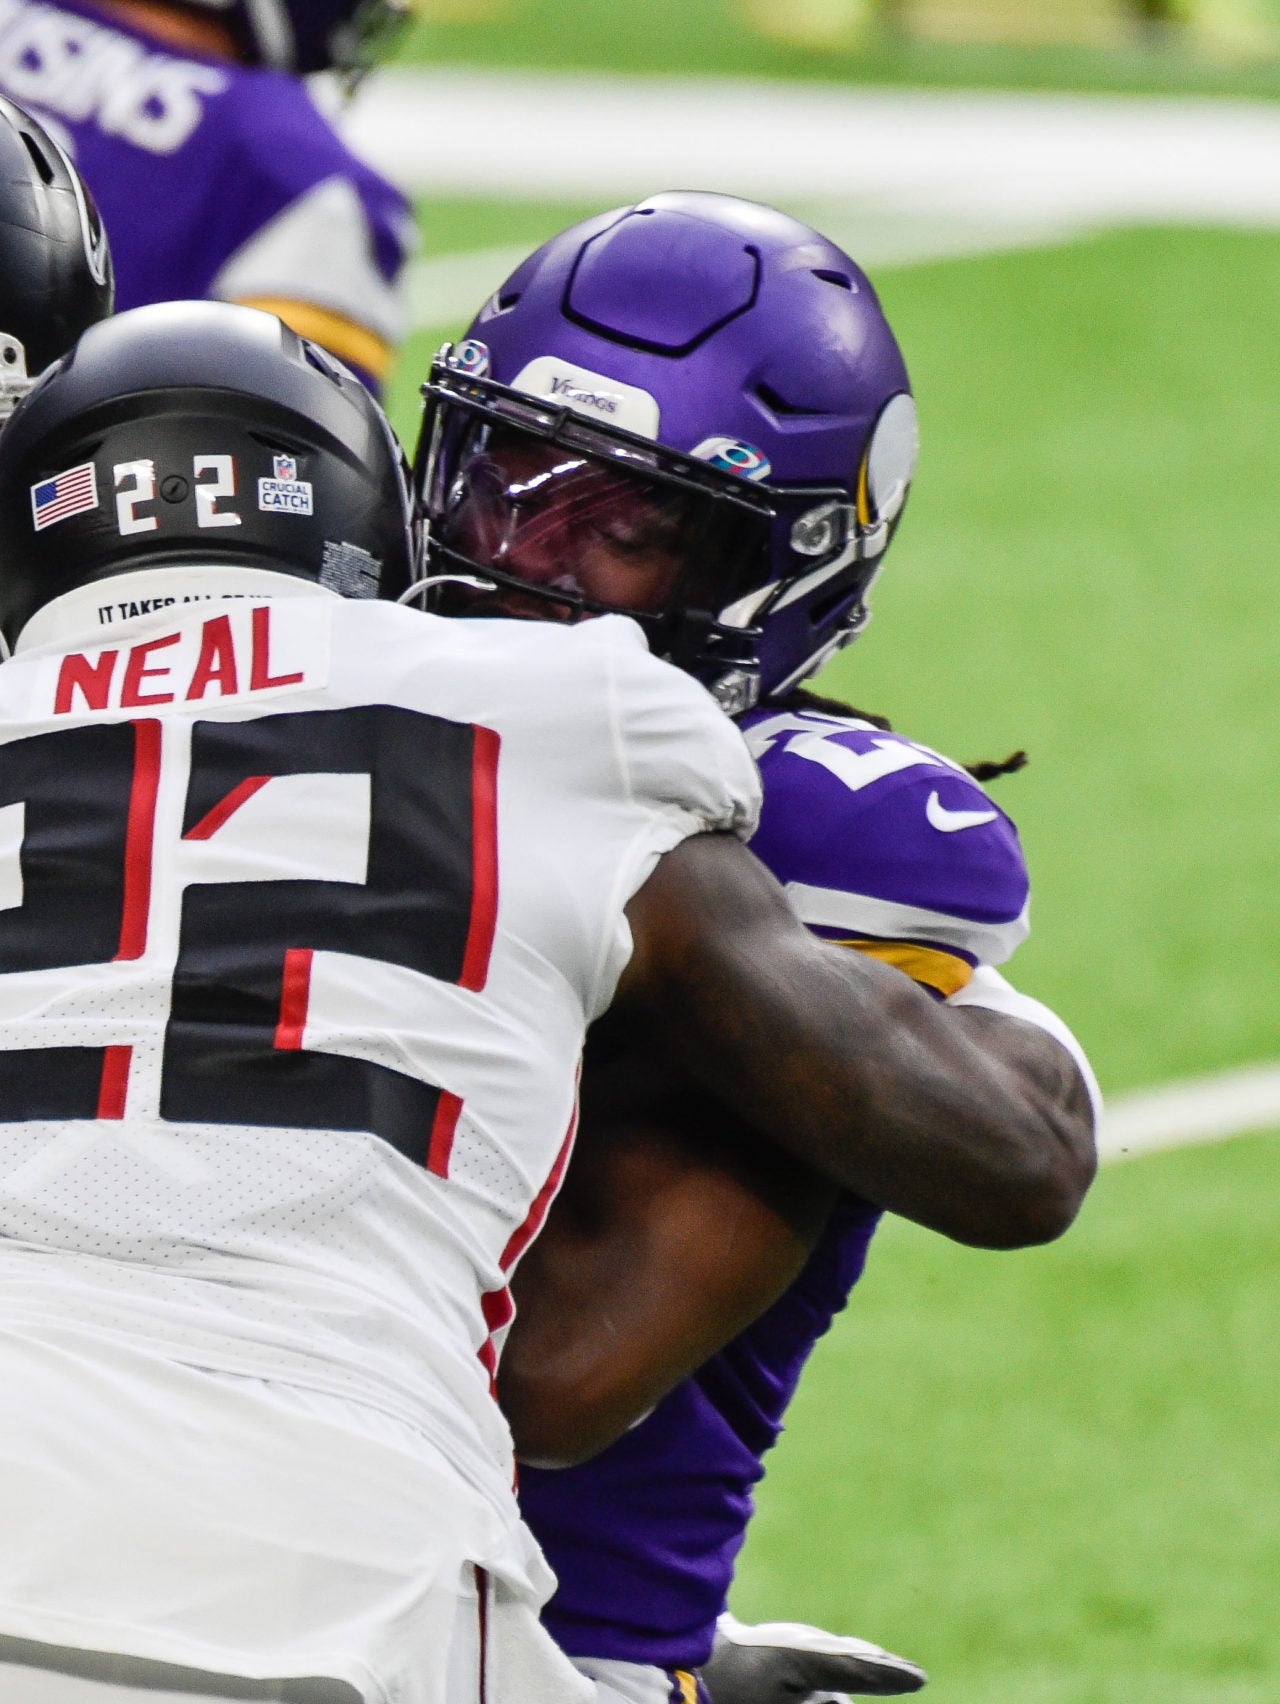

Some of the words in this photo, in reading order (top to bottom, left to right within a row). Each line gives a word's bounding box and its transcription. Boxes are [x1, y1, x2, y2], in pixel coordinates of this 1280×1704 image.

[262, 481, 309, 496] CRUCIAL
[262, 492, 310, 509] CATCH
[98, 606, 114, 625] IT
[53, 606, 304, 715] NEAL
